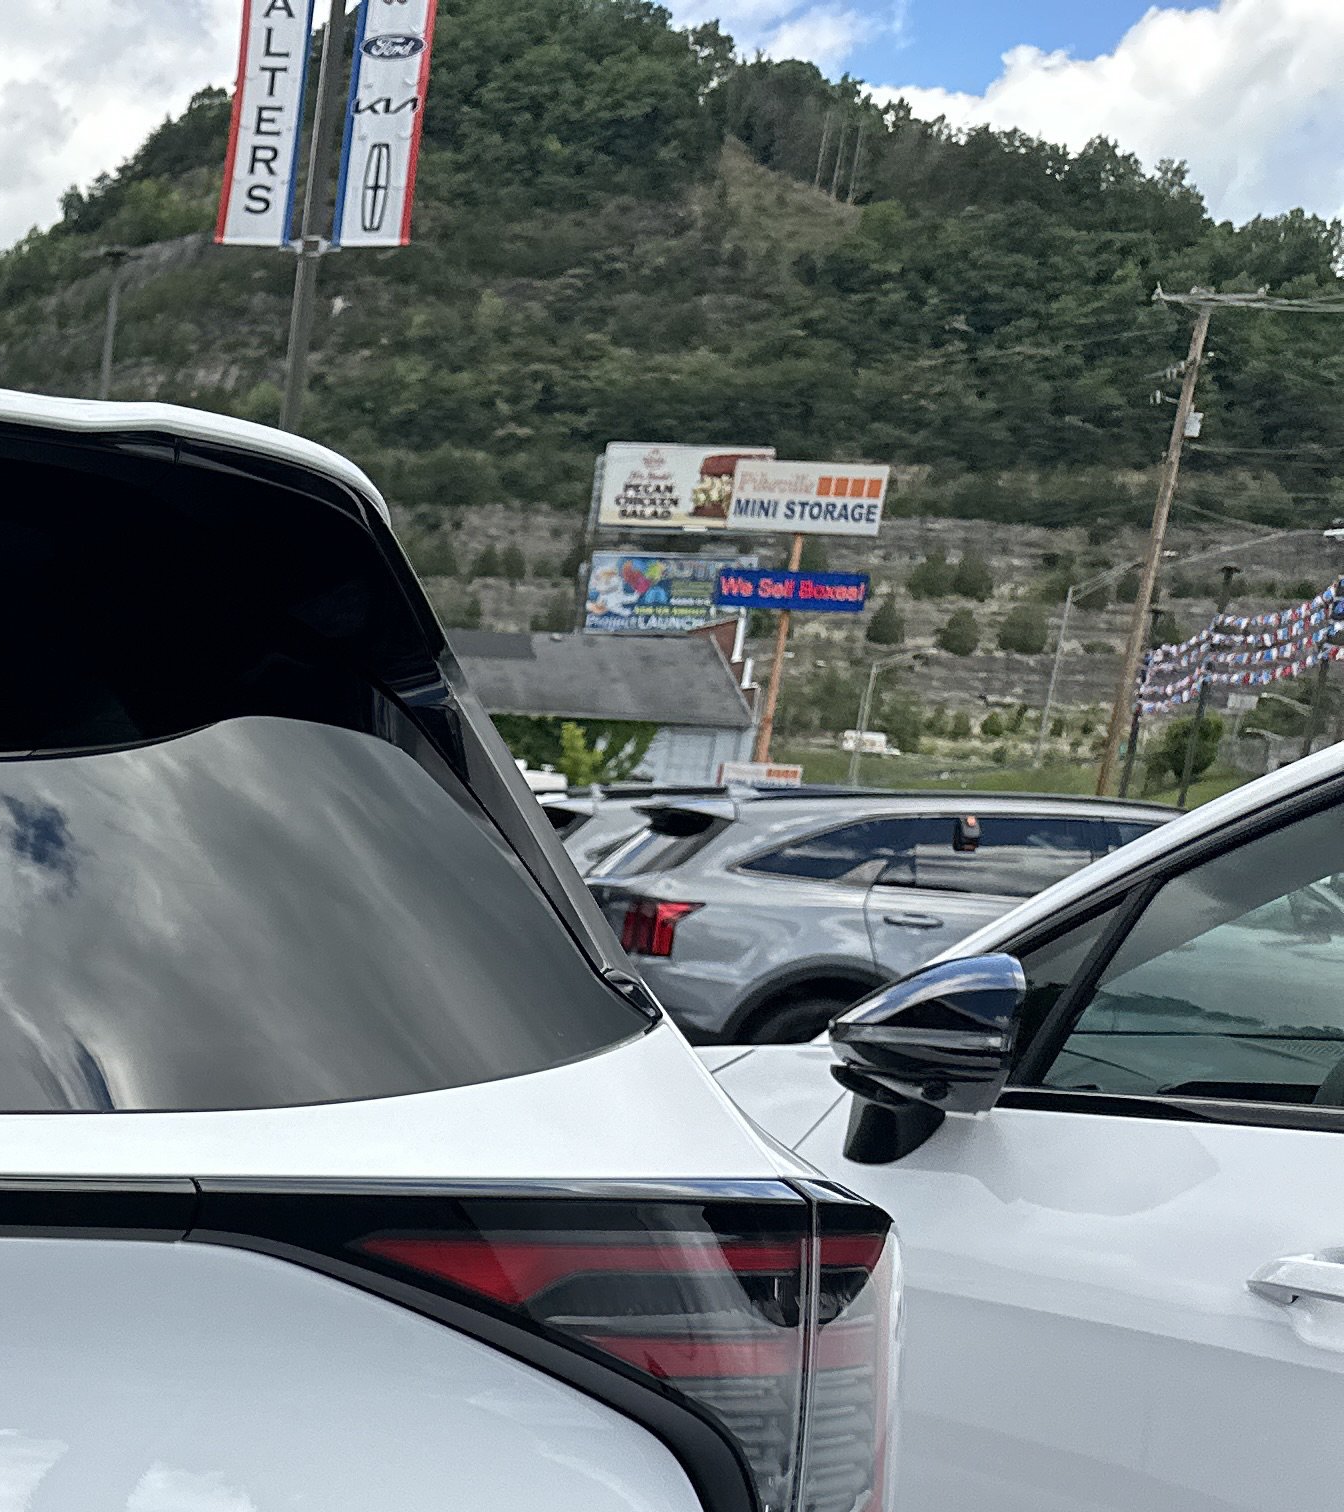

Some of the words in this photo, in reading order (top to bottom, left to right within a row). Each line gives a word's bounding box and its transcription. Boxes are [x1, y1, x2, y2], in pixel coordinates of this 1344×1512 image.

[353, 96, 418, 115] KIA
[624, 483, 674, 494] PECAN
[615, 496, 679, 508] CHICKEN
[734, 498, 778, 519] MINI
[784, 501, 879, 524] STORAGE
[721, 576, 754, 597] We
[758, 578, 795, 599] Sell
